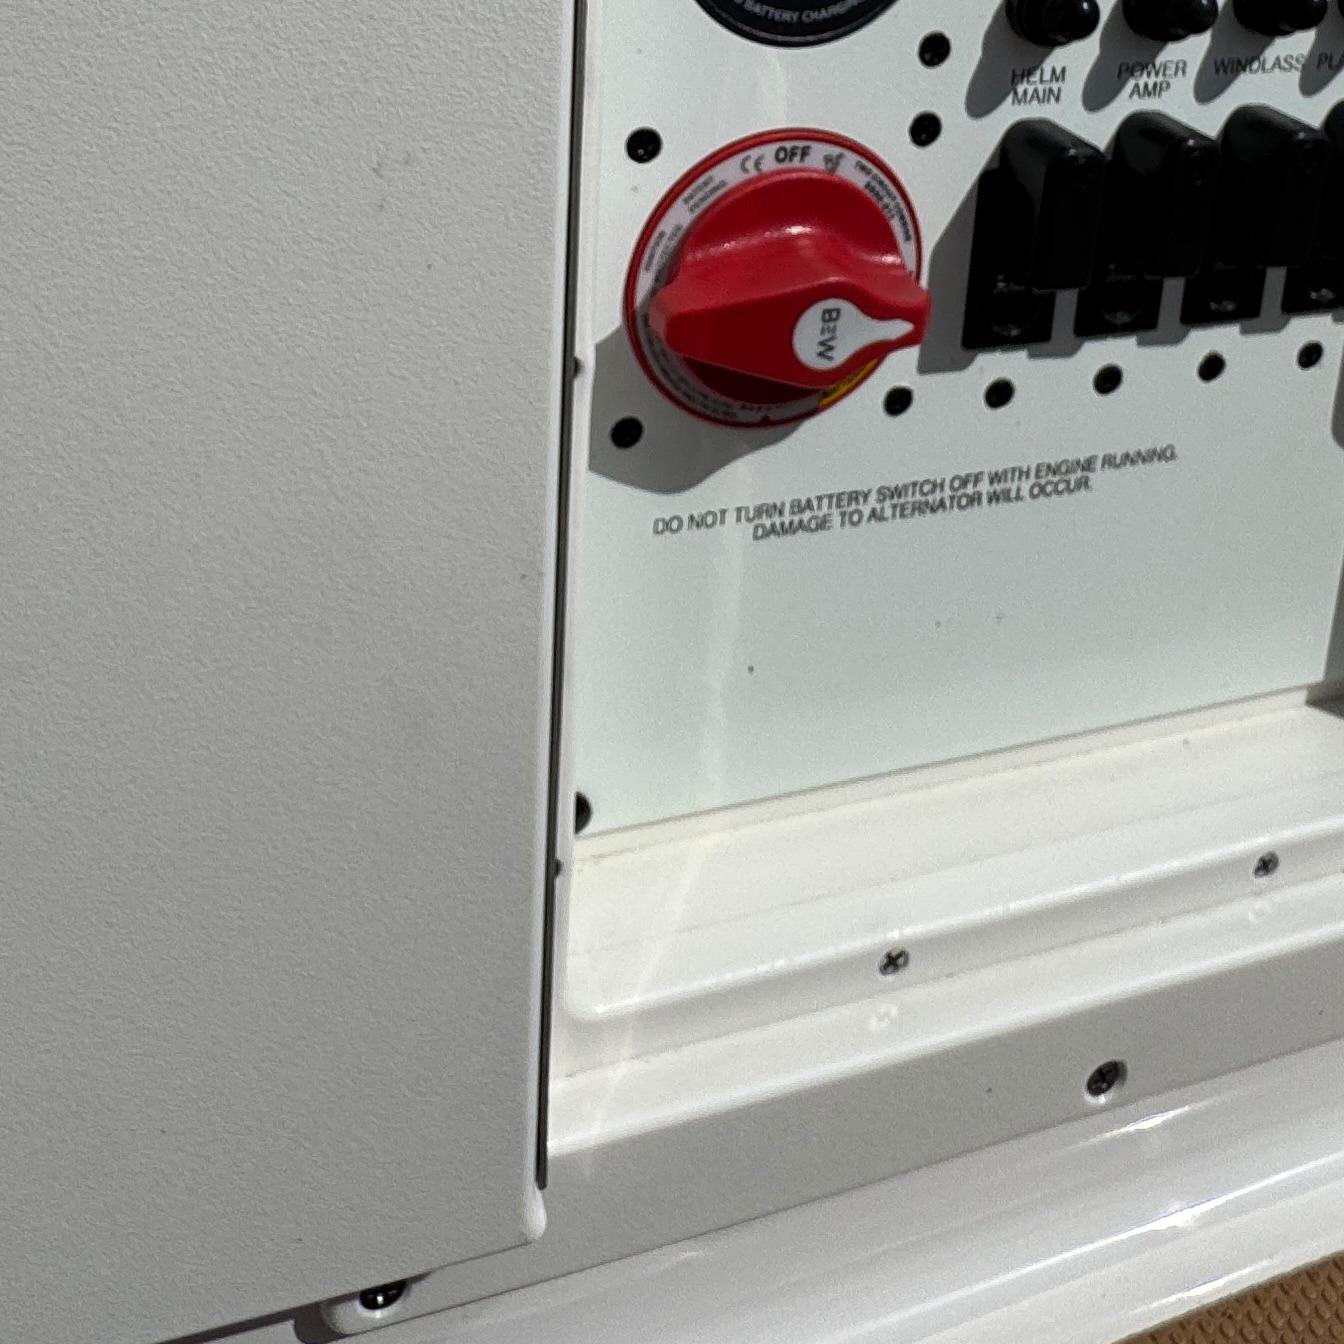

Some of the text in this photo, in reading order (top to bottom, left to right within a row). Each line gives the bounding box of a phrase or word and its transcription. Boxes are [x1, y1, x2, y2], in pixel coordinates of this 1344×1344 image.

[1117, 59, 1188, 80] POWER
[1213, 52, 1304, 75] WINDLASS
[1010, 66, 1066, 87] HELM
[1011, 85, 1062, 106] MAIN
[1130, 79, 1171, 100] AMP
[774, 145, 812, 164] OFF
[653, 515, 682, 536] DO
[687, 507, 729, 530] NOT
[734, 500, 786, 525] TURN
[789, 488, 872, 517] BATTERY
[876, 477, 946, 502] SWITCH
[948, 471, 984, 492] OFF
[988, 464, 1032, 486] WITH
[1034, 454, 1098, 481] ENGINE
[752, 512, 832, 541] DAMAGE
[838, 507, 864, 528] TO
[866, 491, 983, 524] ALTERNATOR
[986, 483, 1027, 505] WILL
